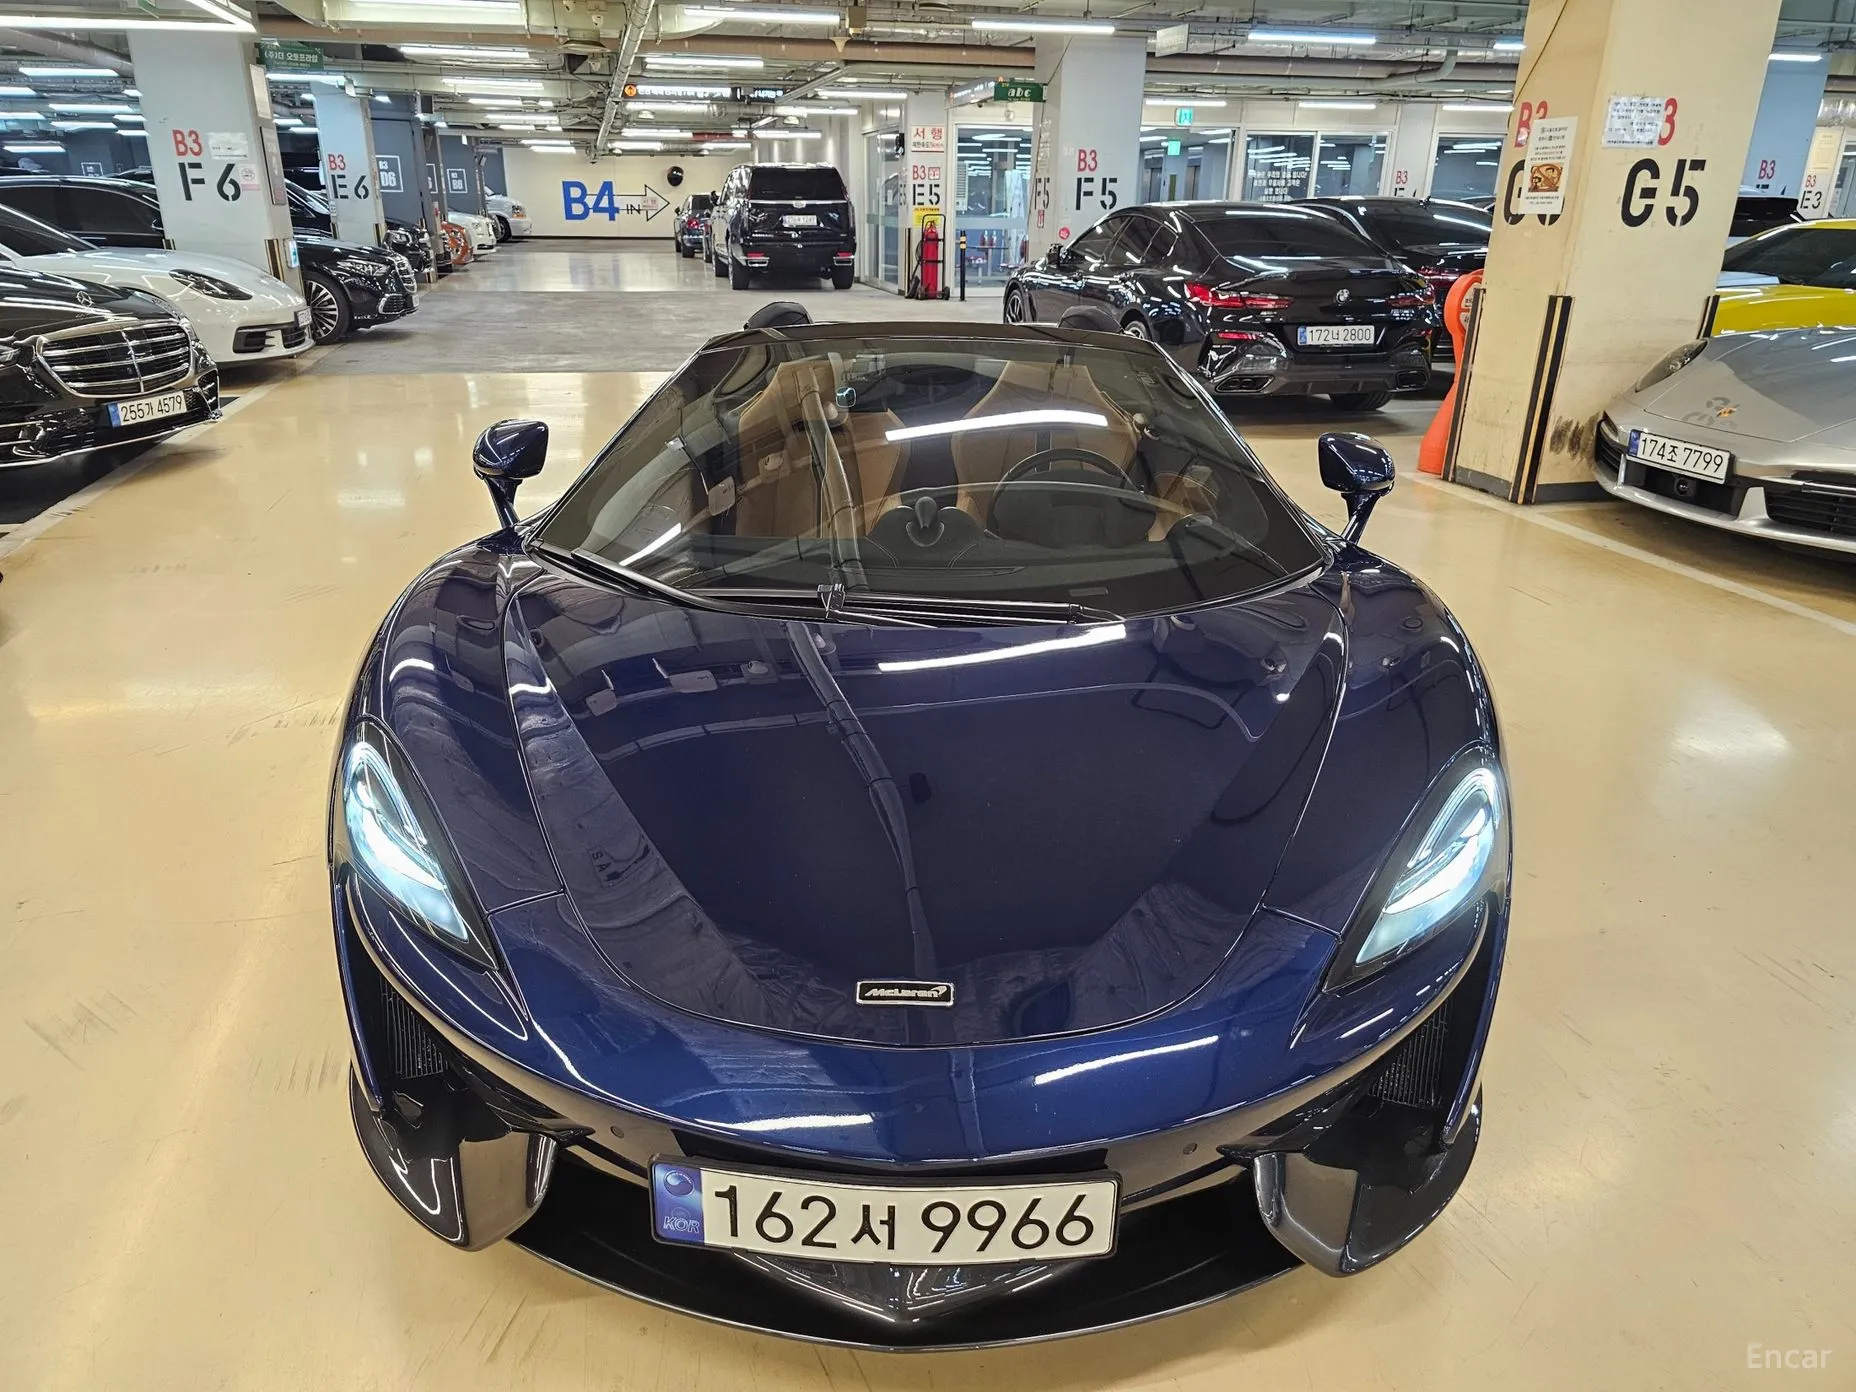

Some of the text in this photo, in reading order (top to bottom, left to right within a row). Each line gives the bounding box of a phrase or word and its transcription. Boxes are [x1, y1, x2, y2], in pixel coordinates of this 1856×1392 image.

[1007, 87, 1032, 97] abc
[171, 129, 203, 157] B3
[328, 154, 346, 171] B3
[1078, 149, 1098, 172] B3
[913, 165, 927, 180] B3
[1395, 170, 1408, 184] B3
[1759, 160, 1776, 180] B3
[380, 171, 397, 187] D6
[1805, 174, 1817, 187] B3
[562, 181, 620, 221] B4
[626, 204, 641, 215] IN
[1343, 328, 1371, 341] 2800
[121, 395, 183, 422] 255가 4579
[1642, 437, 1724, 473] 174조 7799
[864, 987, 939, 998] McLaren
[663, 1215, 700, 1233] KOR
[714, 1184, 1095, 1254] 162서 9966
